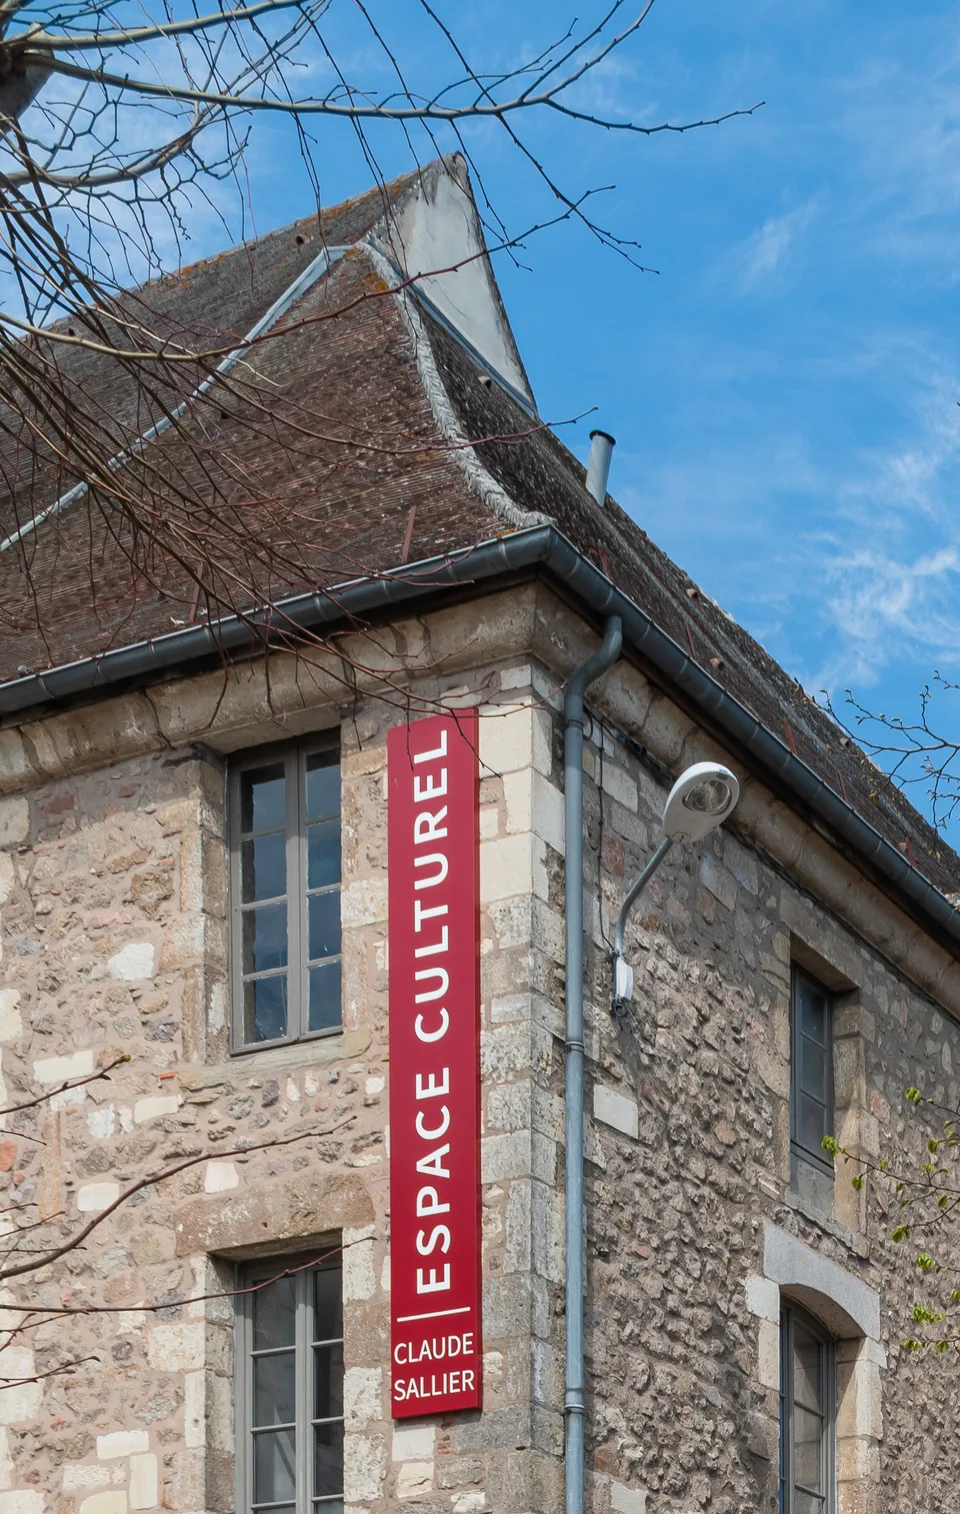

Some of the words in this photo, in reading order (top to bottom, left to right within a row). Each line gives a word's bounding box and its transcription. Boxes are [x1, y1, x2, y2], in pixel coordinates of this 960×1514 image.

[413, 729, 450, 1043] CULTUREL
[415, 1066, 451, 1295] ESPACE
[394, 1332, 474, 1365] CLAUDE
[394, 1369, 475, 1402] SALLIER
